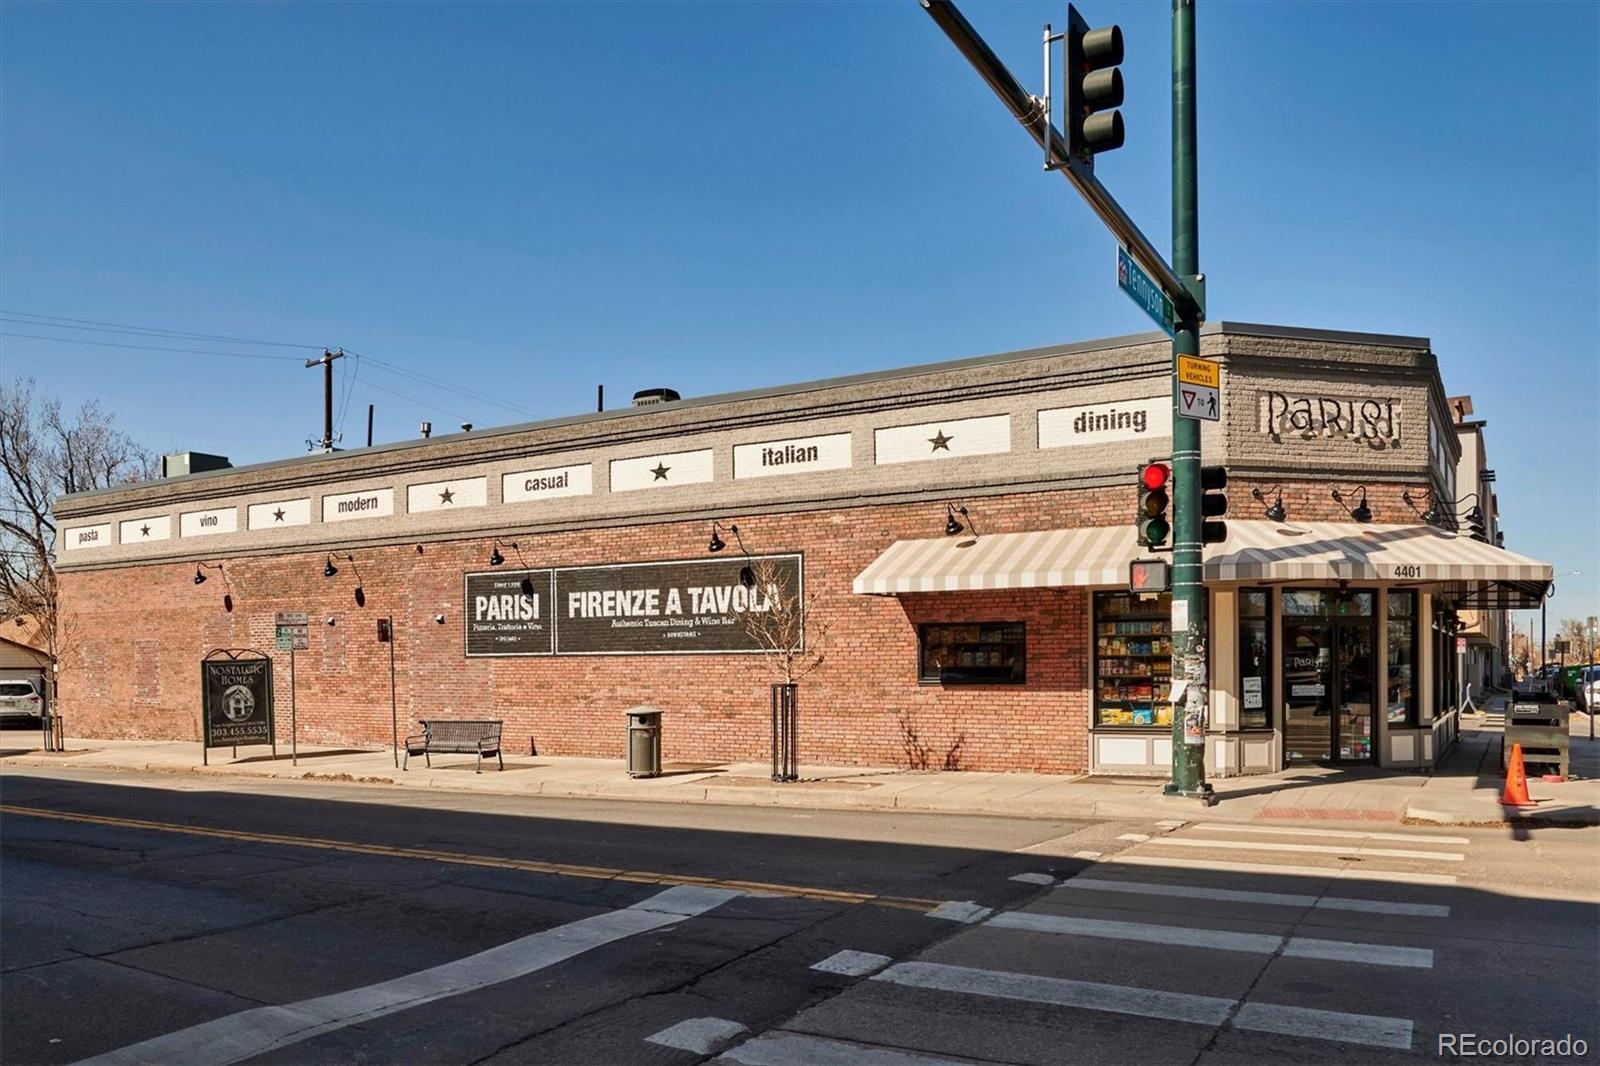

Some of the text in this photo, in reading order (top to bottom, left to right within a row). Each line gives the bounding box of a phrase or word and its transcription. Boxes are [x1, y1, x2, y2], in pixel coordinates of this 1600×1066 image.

[1128, 259, 1164, 319] Tennyson
[1187, 361, 1212, 372] TURNING
[1185, 372, 1213, 383] VEHICLES
[1073, 409, 1147, 433] dining
[762, 444, 818, 466] italian
[525, 471, 568, 491] casual
[338, 496, 378, 513] modern
[200, 513, 218, 527] vino
[78, 529, 98, 545] pasta
[1394, 565, 1421, 577] 4401
[475, 593, 539, 620] PARISI
[568, 584, 782, 618] FIRENZE A TAVOLA
[611, 616, 736, 628] Authentic Tuscan Dining & Wine Bar
[210, 665, 264, 675] NOSTALGIC
[221, 676, 254, 685] HOMES
[211, 726, 268, 737] 303.455.5535
